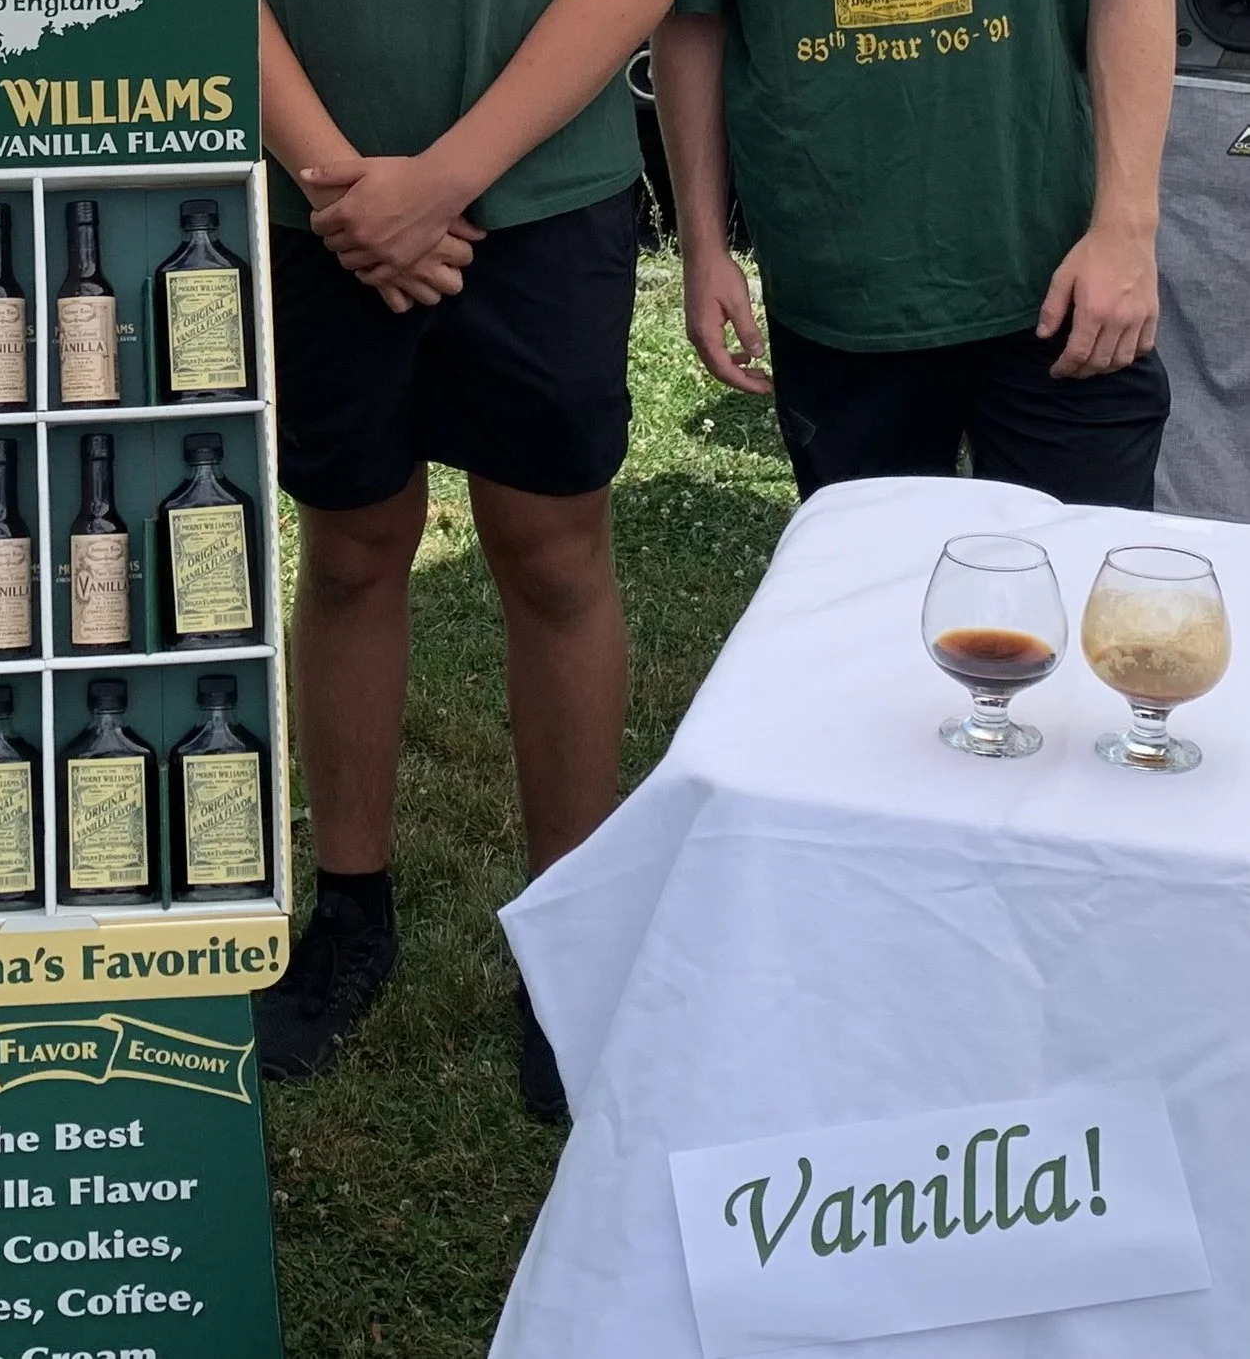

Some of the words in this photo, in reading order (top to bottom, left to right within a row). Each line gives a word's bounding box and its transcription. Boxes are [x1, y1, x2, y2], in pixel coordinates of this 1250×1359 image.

[797, 30, 846, 62] 85th
[855, 33, 923, 65] Year
[0, 75, 234, 129] WILLIAMS
[128, 129, 247, 154] FLAVOR
[176, 323, 204, 343] VANILLA
[206, 308, 233, 330] FLAVOR
[184, 299, 225, 328] ORIGINAL
[62, 341, 103, 353] ANILLA
[181, 563, 210, 584] VANILLA
[211, 546, 238, 568] FLAVOR
[187, 538, 229, 568] ORIGINAL
[76, 817, 107, 838] VANILLA
[109, 800, 137, 822] FLAVOR
[84, 791, 128, 821] ORIGINAL
[193, 813, 223, 834] VANILLA
[225, 796, 252, 818] FLAVOR
[200, 787, 243, 817] ORIGINAL
[81, 935, 280, 980] Favorite!
[128, 1040, 230, 1075] ECONOMY
[55, 1118, 144, 1151] Best
[69, 1175, 198, 1206] Flavor
[724, 1124, 1107, 1269] Vanilla!
[2, 1229, 183, 1264] Cookies,
[57, 1284, 204, 1317] Coffee,
